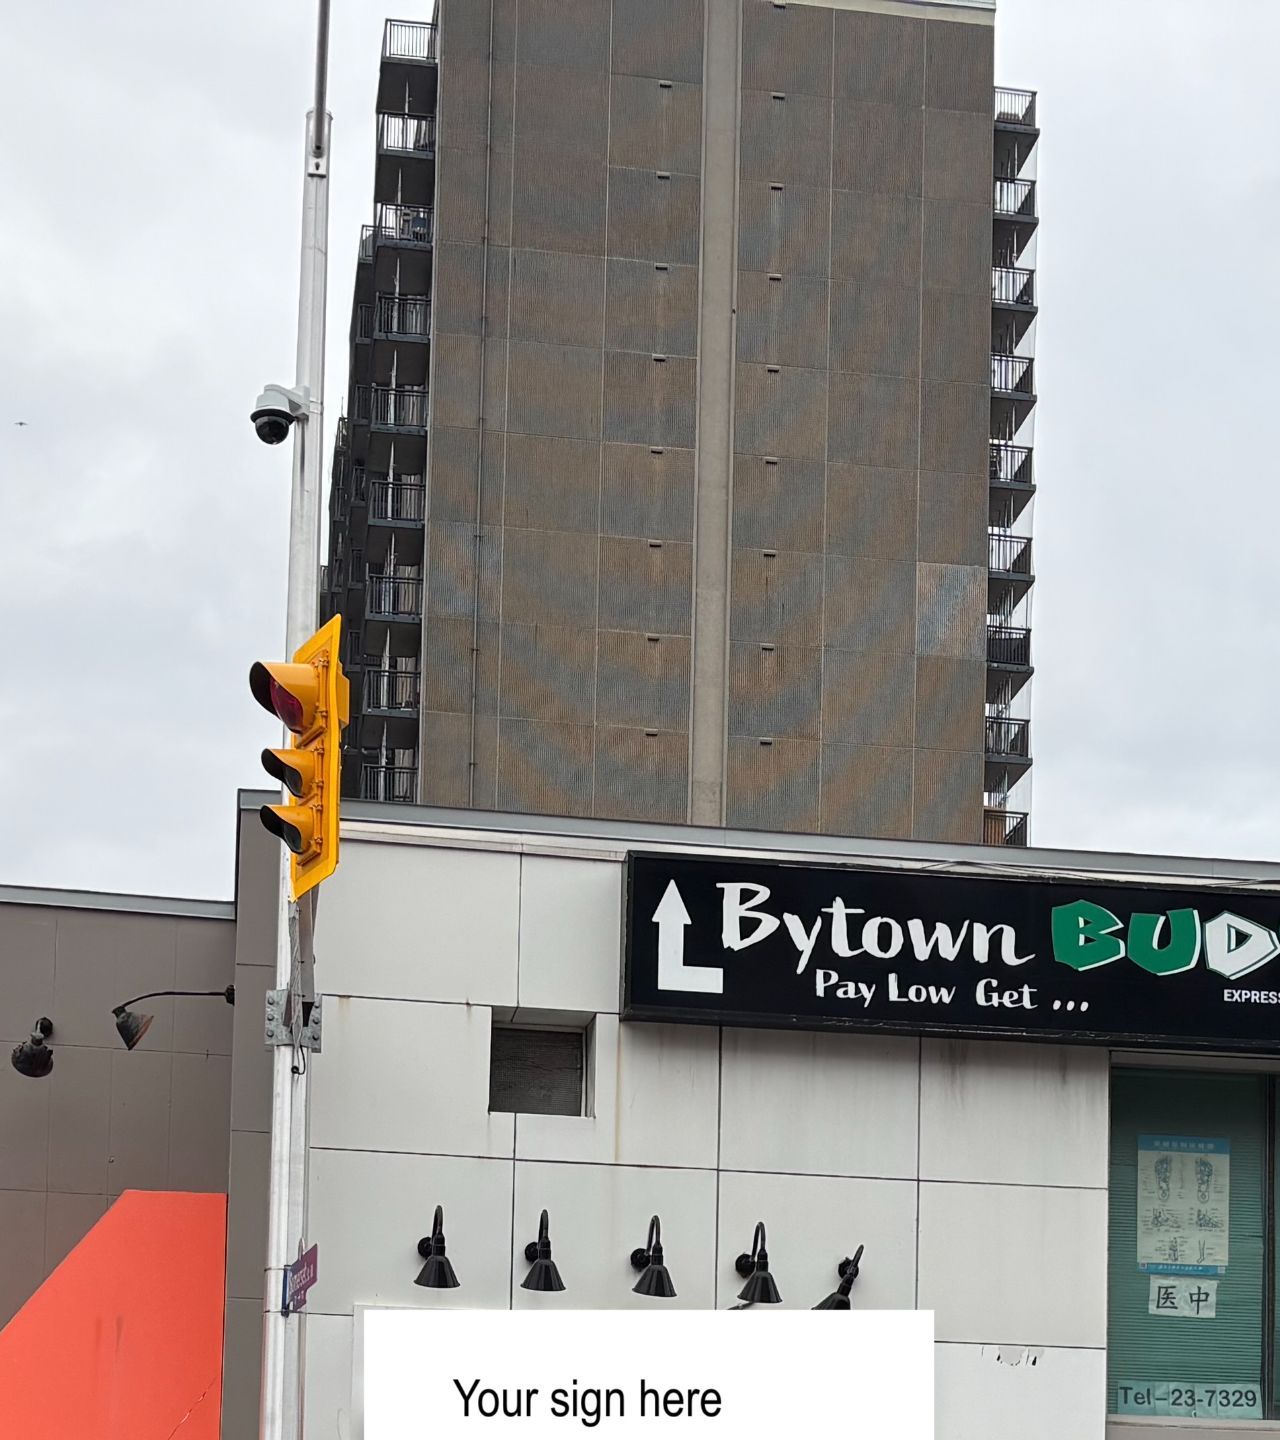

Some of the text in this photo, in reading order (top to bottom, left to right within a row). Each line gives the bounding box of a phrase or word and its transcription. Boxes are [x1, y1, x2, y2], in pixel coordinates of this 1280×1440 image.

[716, 882, 1036, 975] Bytown
[816, 969, 875, 1008] Pay
[888, 973, 956, 1004] Low
[975, 978, 1038, 1009] Get
